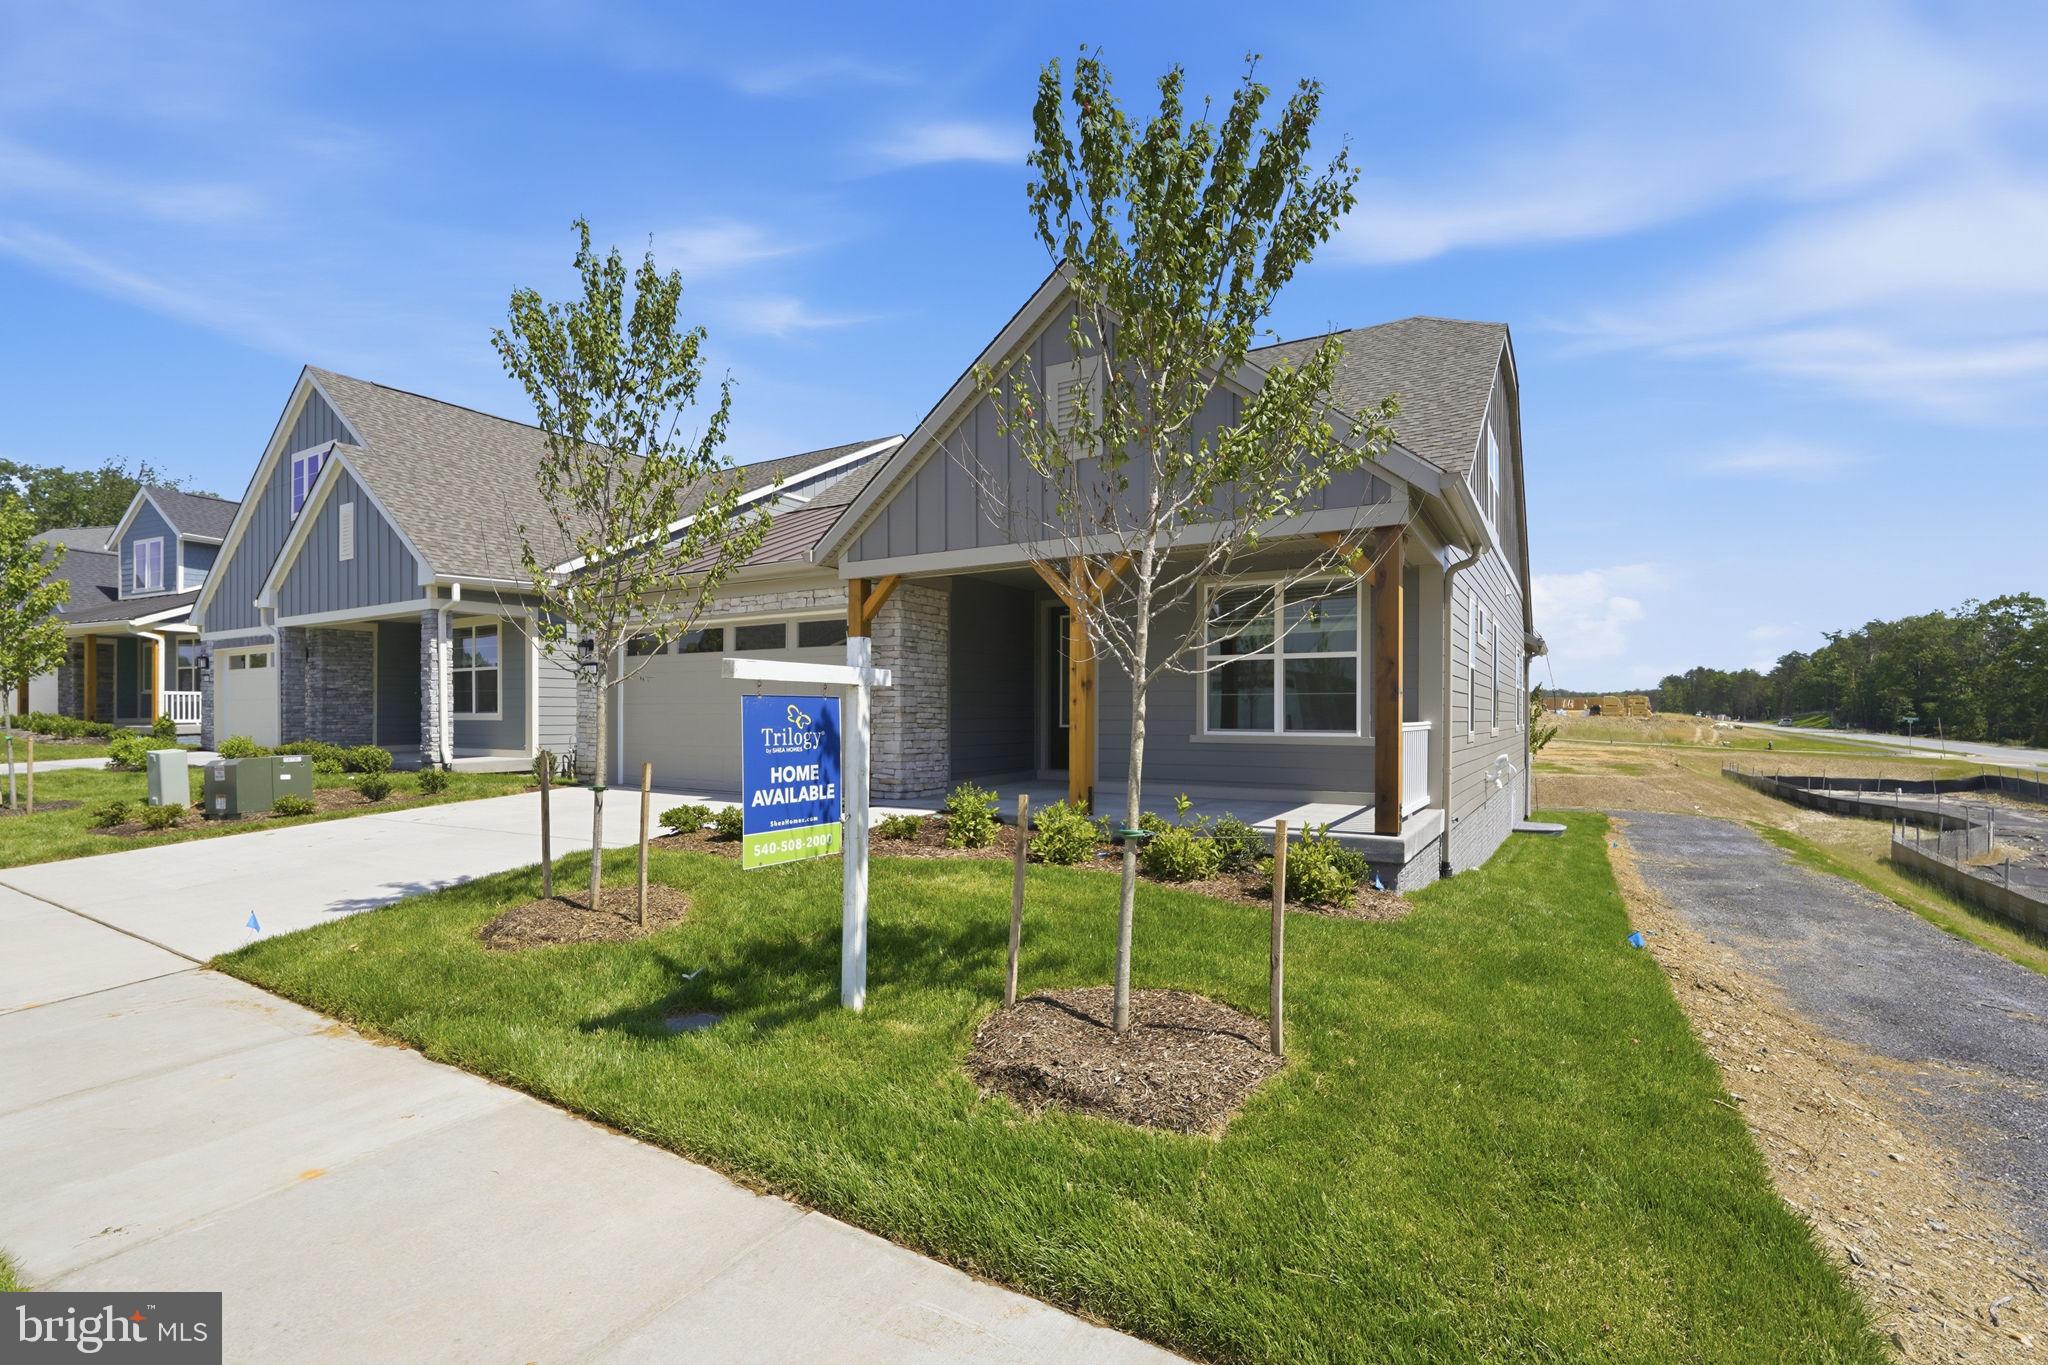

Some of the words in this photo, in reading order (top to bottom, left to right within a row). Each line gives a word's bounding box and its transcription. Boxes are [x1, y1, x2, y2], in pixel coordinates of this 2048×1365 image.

[761, 727, 821, 750] Trilogy
[770, 764, 820, 784] HOME
[751, 783, 835, 807] AVAILABLE
[769, 816, 819, 827] SheaHomes.com
[753, 833, 833, 857] 540-508-2000
